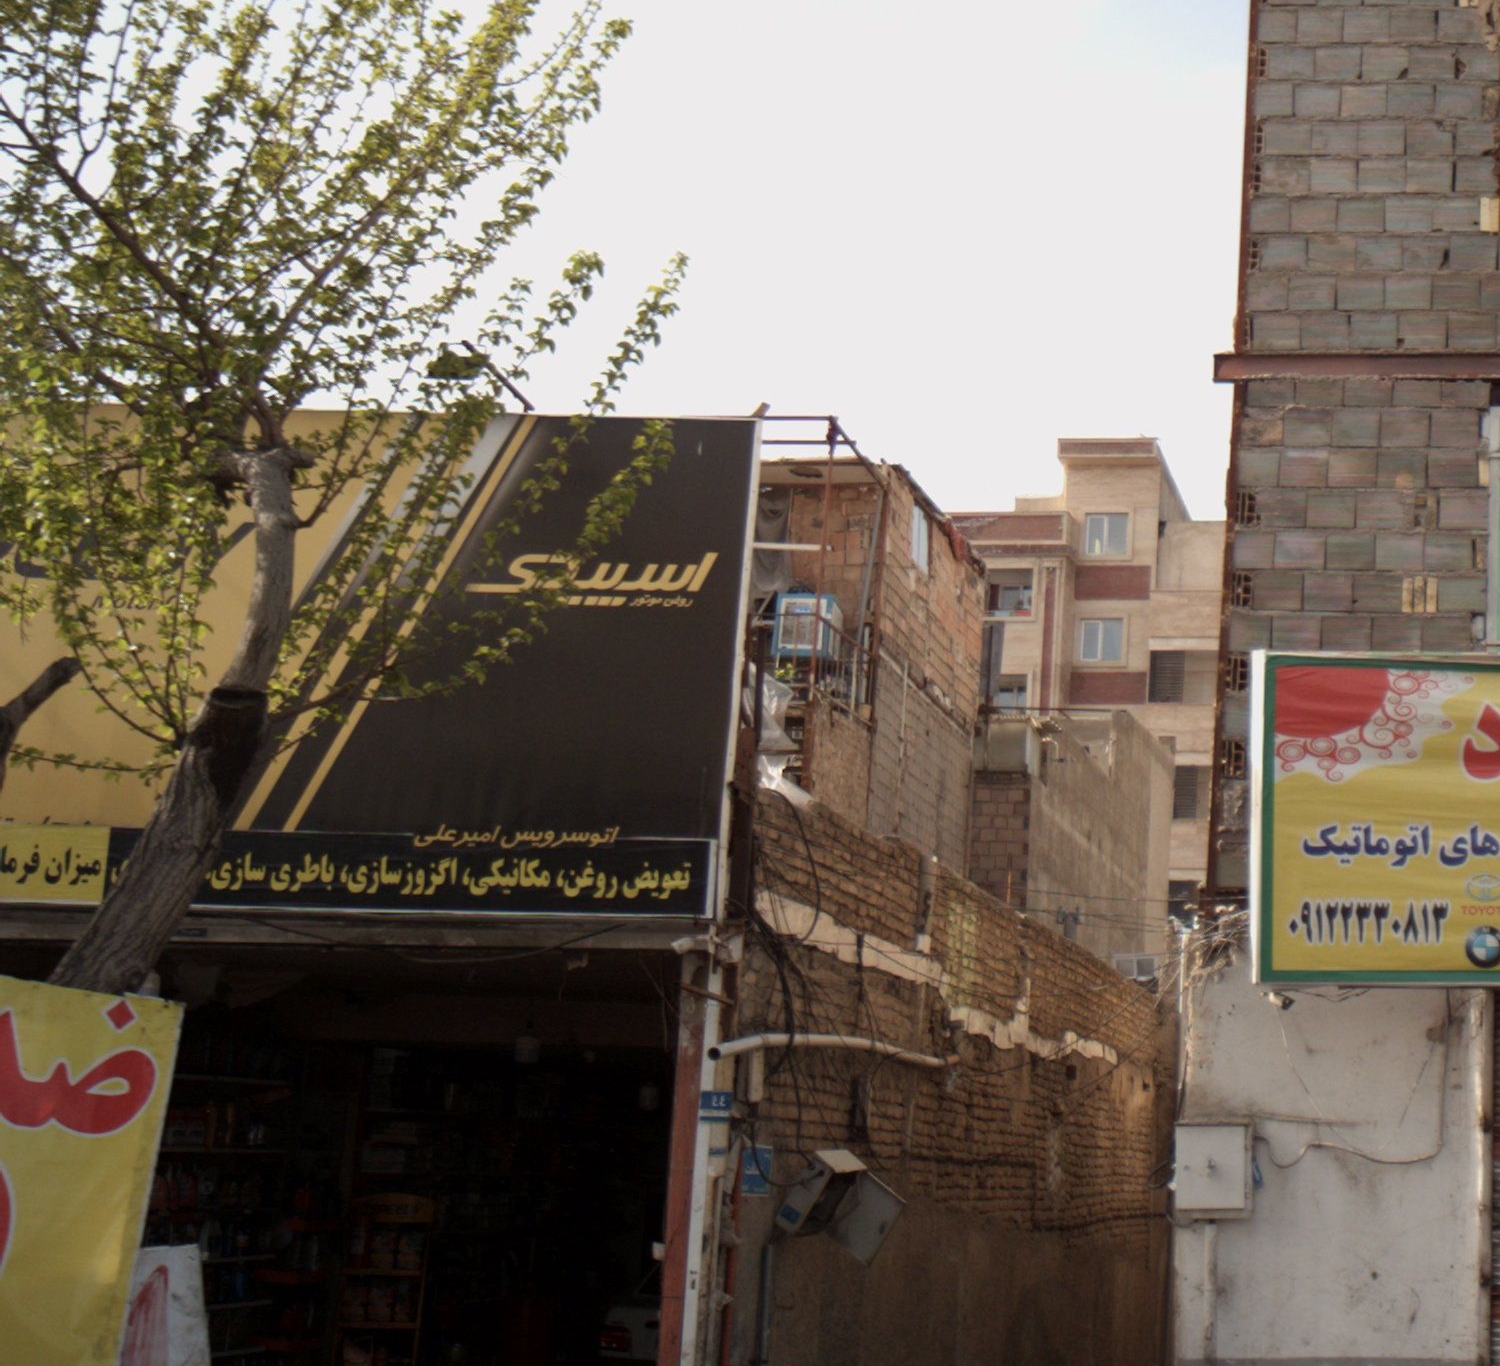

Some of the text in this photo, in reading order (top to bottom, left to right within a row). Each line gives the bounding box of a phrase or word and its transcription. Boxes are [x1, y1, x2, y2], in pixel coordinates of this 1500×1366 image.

[662, 597, 694, 607] روغن
[1302, 824, 1431, 866] اتوماتیک
[1439, 825, 1500, 866] های
[44, 847, 101, 885] میزان
[270, 852, 336, 892] باطری
[622, 862, 692, 899] تعویض
[1288, 900, 1450, 944] ۰۹۱۲۲۳۳۰۸۱۳
